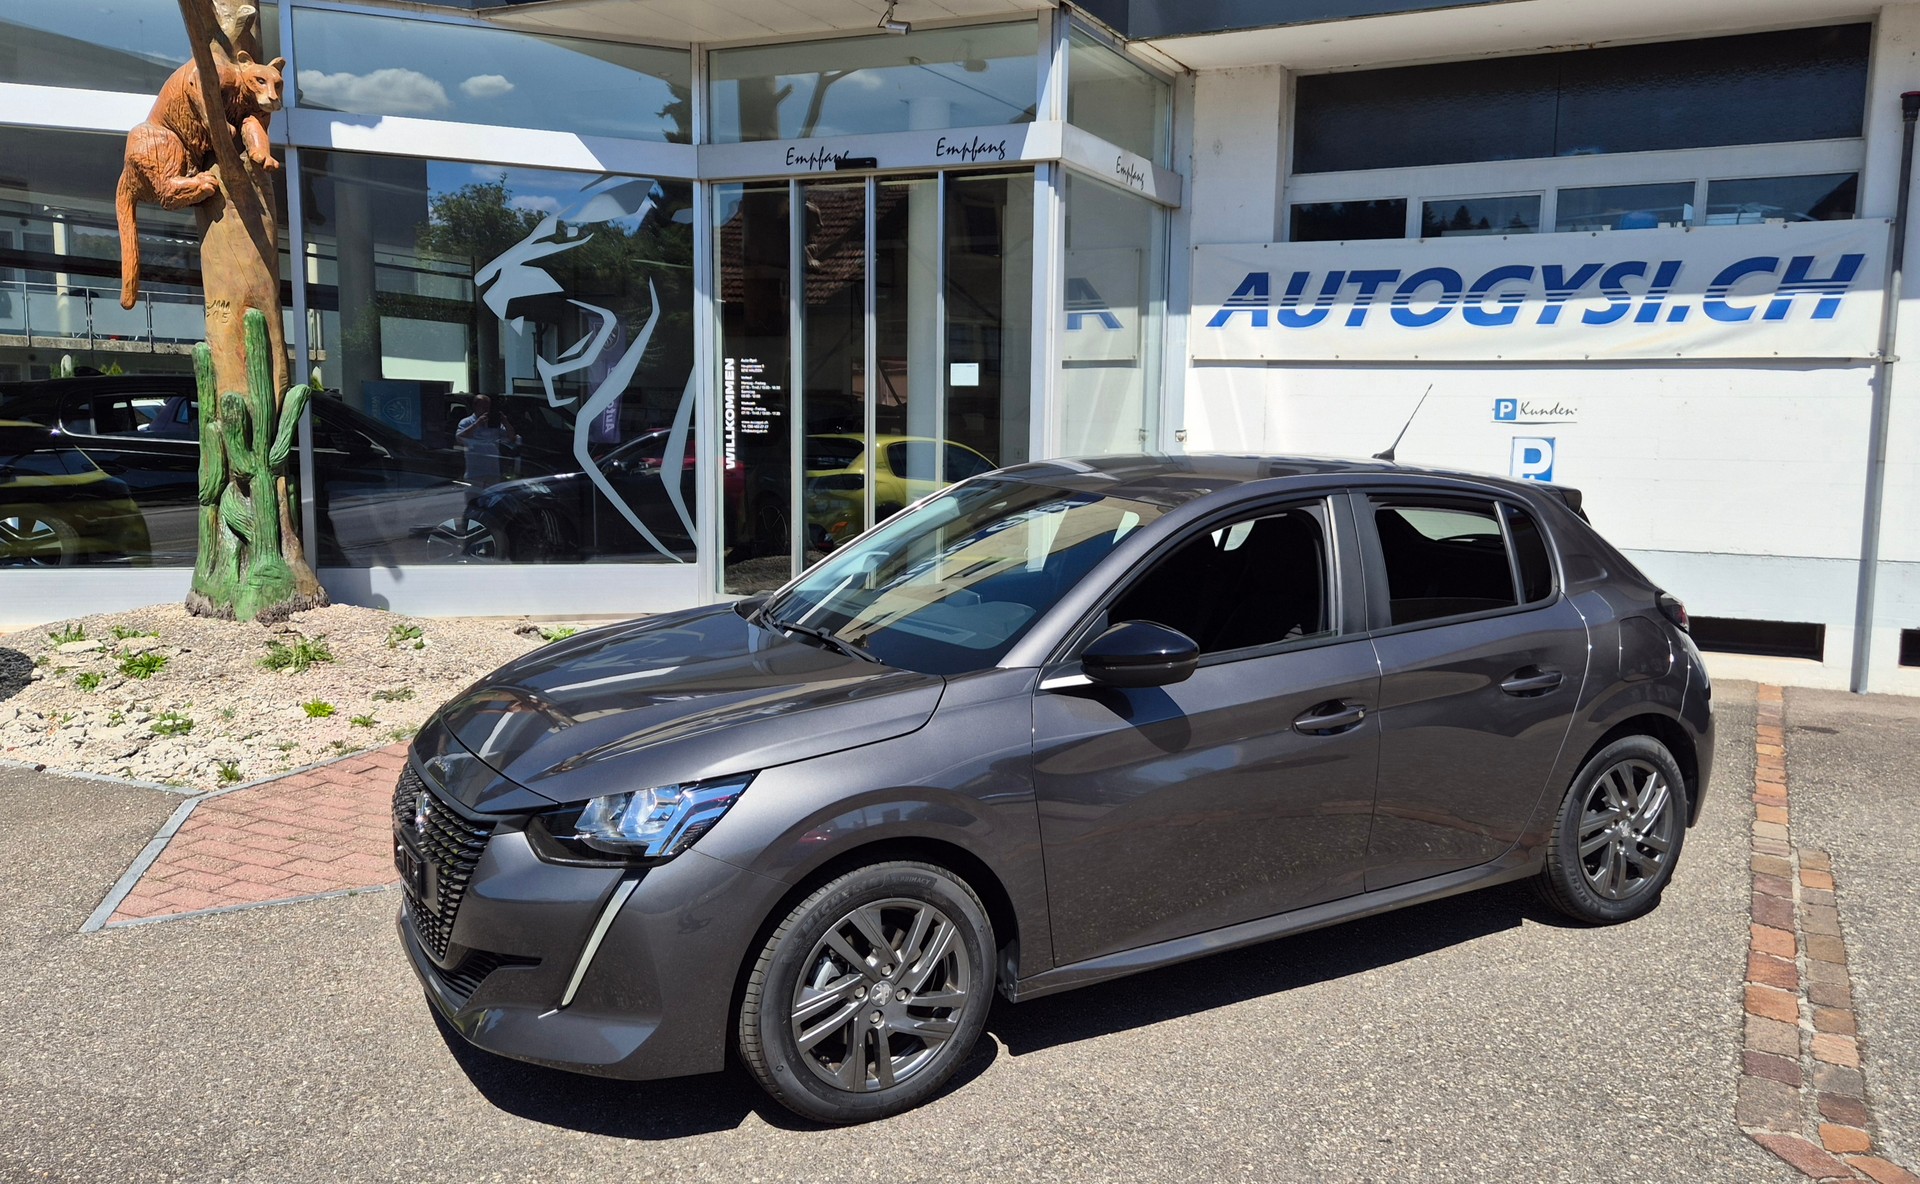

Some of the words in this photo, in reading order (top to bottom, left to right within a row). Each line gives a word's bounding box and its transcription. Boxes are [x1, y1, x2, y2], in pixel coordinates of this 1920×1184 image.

[936, 136, 1006, 161] Empfang
[1116, 156, 1144, 191] Empfang
[1205, 254, 1866, 328] AUTOGYSI.CH
[724, 358, 736, 469] WILLKOMMEN
[1500, 401, 1513, 418] P
[1520, 401, 1574, 416] Kunden
[1511, 438, 1553, 480] P
